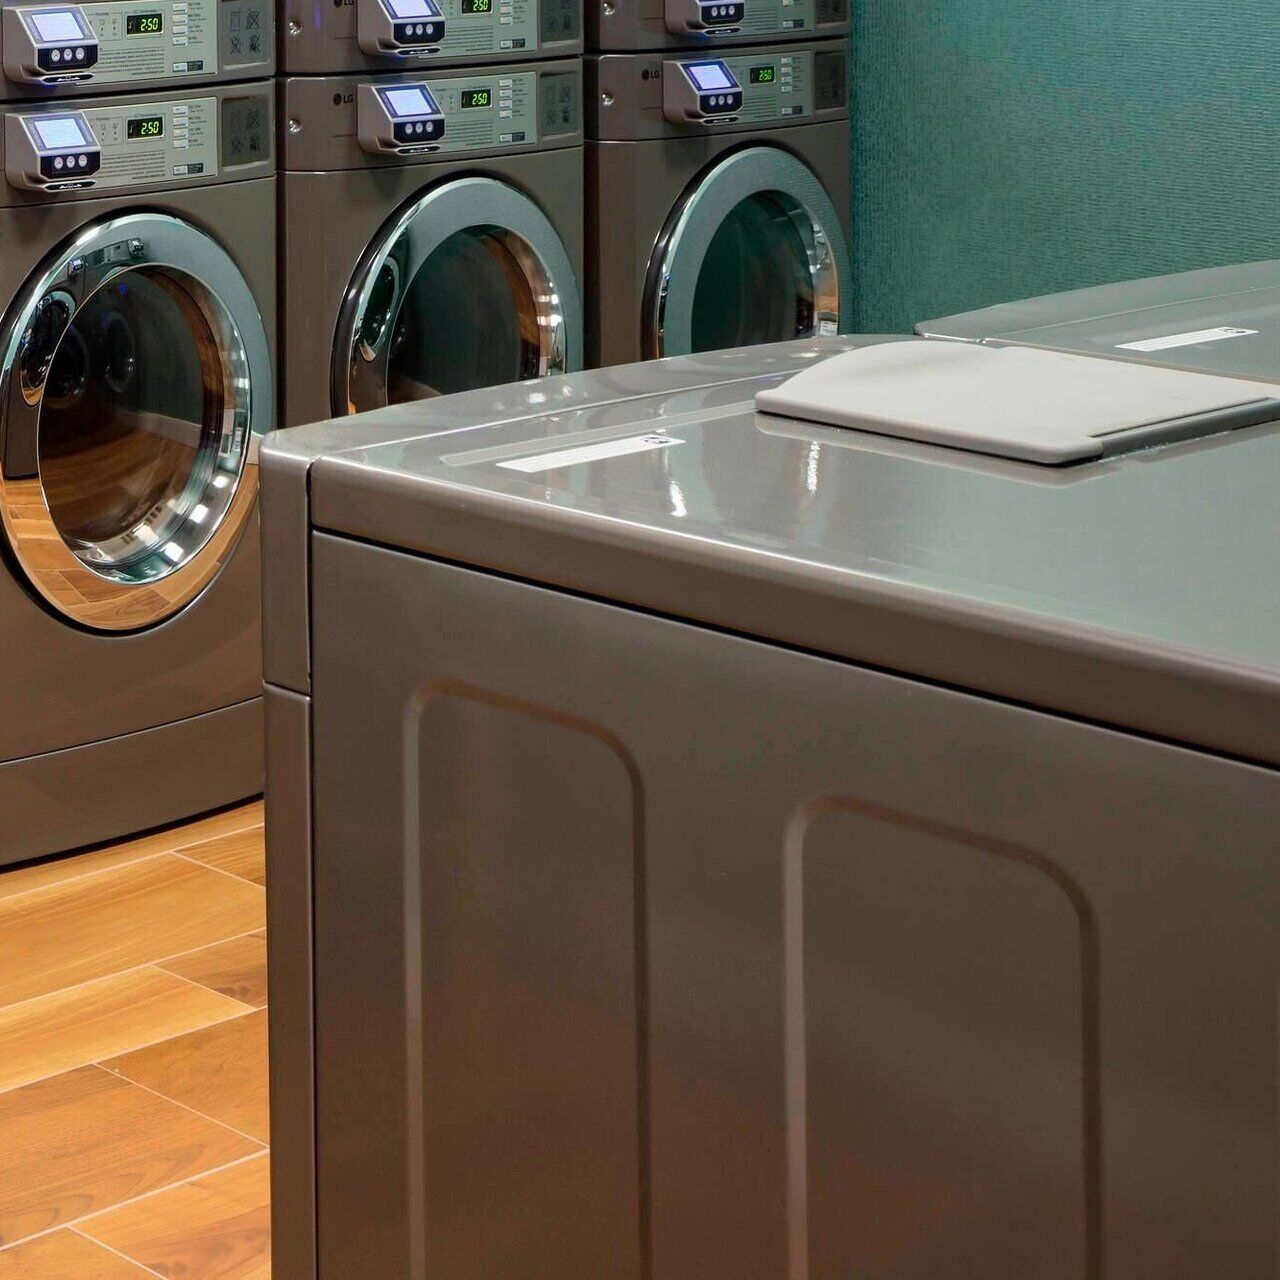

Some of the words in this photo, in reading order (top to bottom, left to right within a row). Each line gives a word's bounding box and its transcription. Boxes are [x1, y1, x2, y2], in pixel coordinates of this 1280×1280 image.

[472, 0, 488, 11] 2.50
[140, 18, 158, 31] 2.50
[343, 95, 354, 103] LG
[471, 93, 487, 105] 2.50
[141, 121, 159, 134] 2.50
